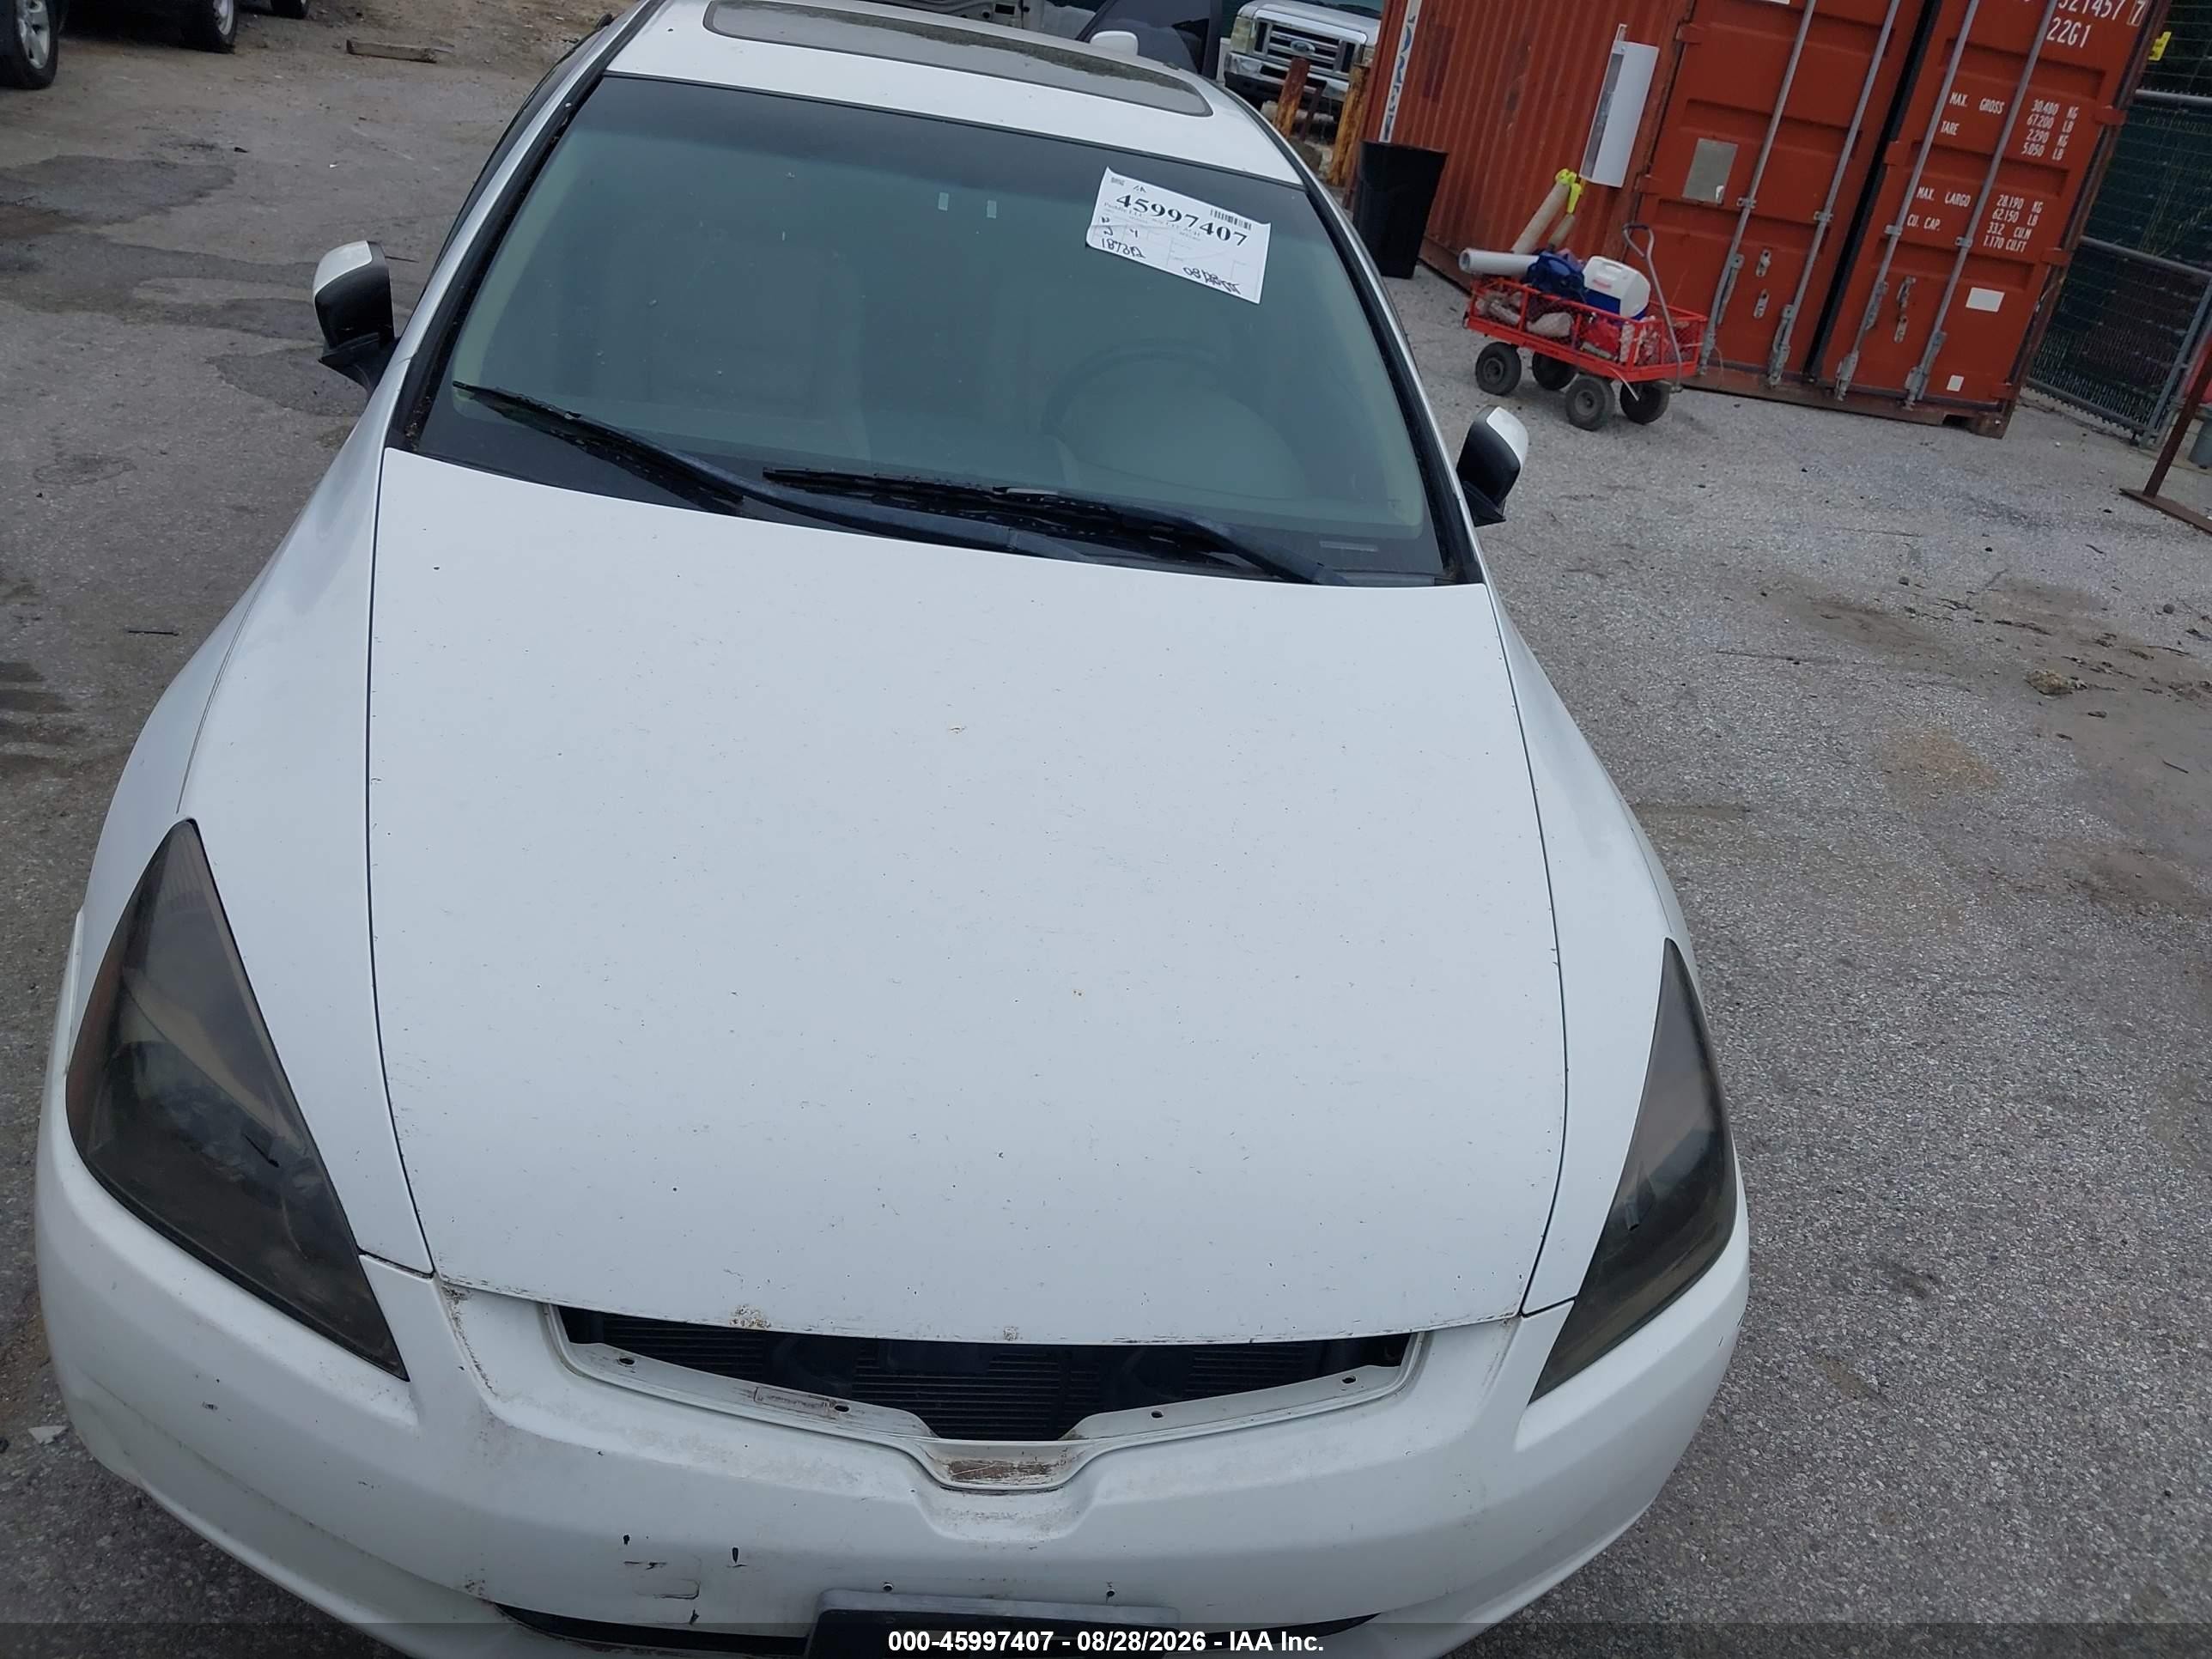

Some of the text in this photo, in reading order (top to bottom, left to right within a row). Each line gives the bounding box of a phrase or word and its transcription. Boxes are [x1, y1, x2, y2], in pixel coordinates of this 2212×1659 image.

[2130, 1, 2147, 25] 7
[2046, 16, 2091, 48] 22G1
[1949, 92, 1968, 107] MAX.
[1979, 98, 2005, 115] GROSS
[2066, 106, 2079, 119] KG
[1941, 120, 1960, 136] TARE
[2057, 135, 2069, 148] KG
[2062, 120, 2075, 133] LB
[2051, 148, 2063, 161] LB
[1917, 186, 1935, 201] MAX.
[2032, 201, 2044, 214] KG
[1116, 194, 1248, 246] 45997407
[1907, 214, 1919, 228] CU.
[1923, 216, 1941, 232] CAP.
[2027, 215, 2039, 227] LB
